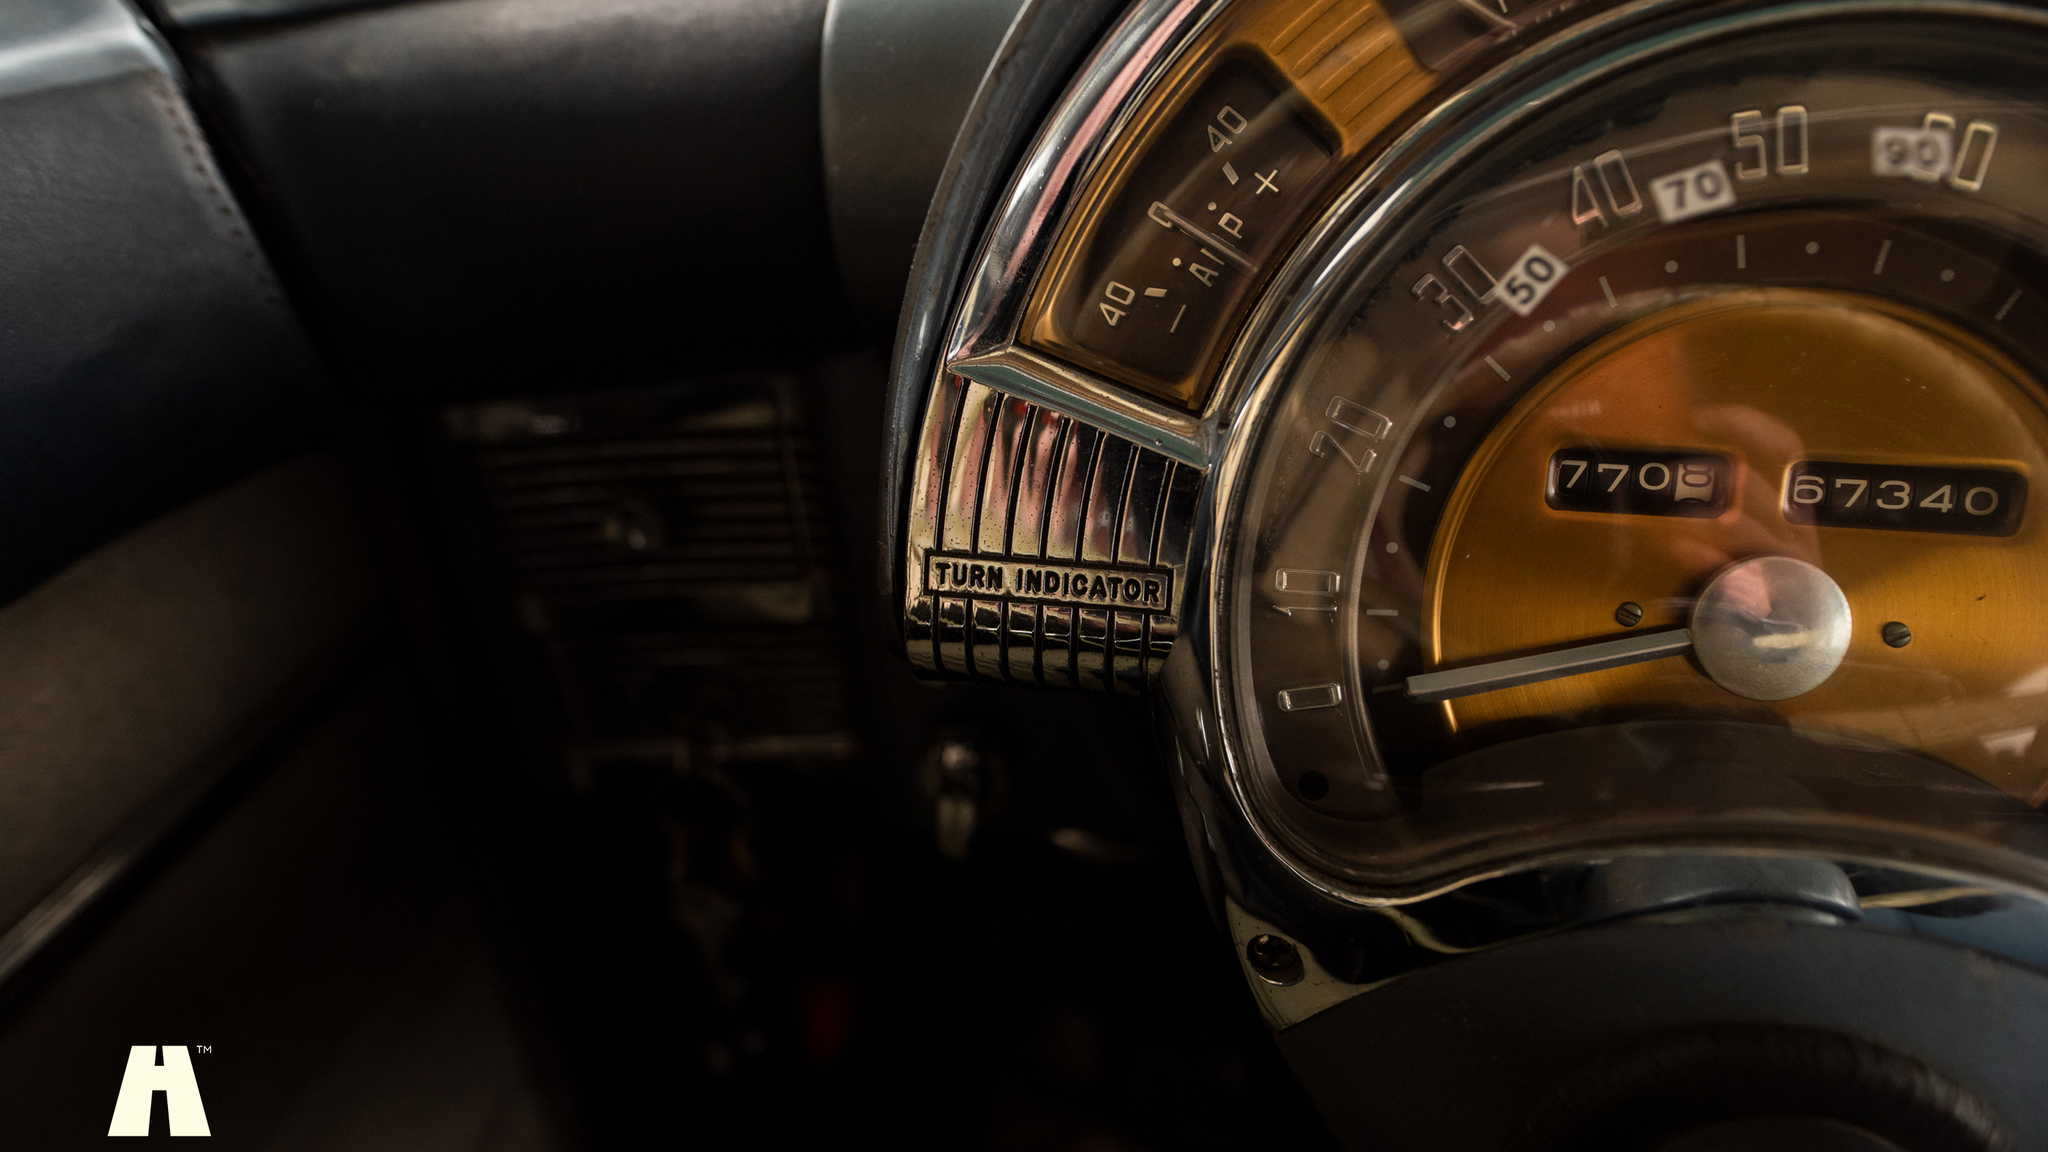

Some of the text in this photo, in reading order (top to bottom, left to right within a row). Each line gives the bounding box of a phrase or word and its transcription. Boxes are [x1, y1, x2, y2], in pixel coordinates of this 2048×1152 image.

[1207, 105, 1248, 153] 40
[1729, 105, 1809, 181] 50
[1885, 135, 1942, 167] 90
[1571, 148, 1643, 228] 40
[1662, 169, 1725, 212] 70
[1098, 280, 1136, 327] 40
[1411, 244, 1500, 332] 30
[1504, 255, 1555, 306] 50
[1309, 395, 1393, 474] 20
[1791, 471, 2000, 517] 67340
[934, 562, 1161, 603] TURN INDICATOR
[1272, 567, 1341, 616] 10
[1277, 682, 1343, 713] 0
